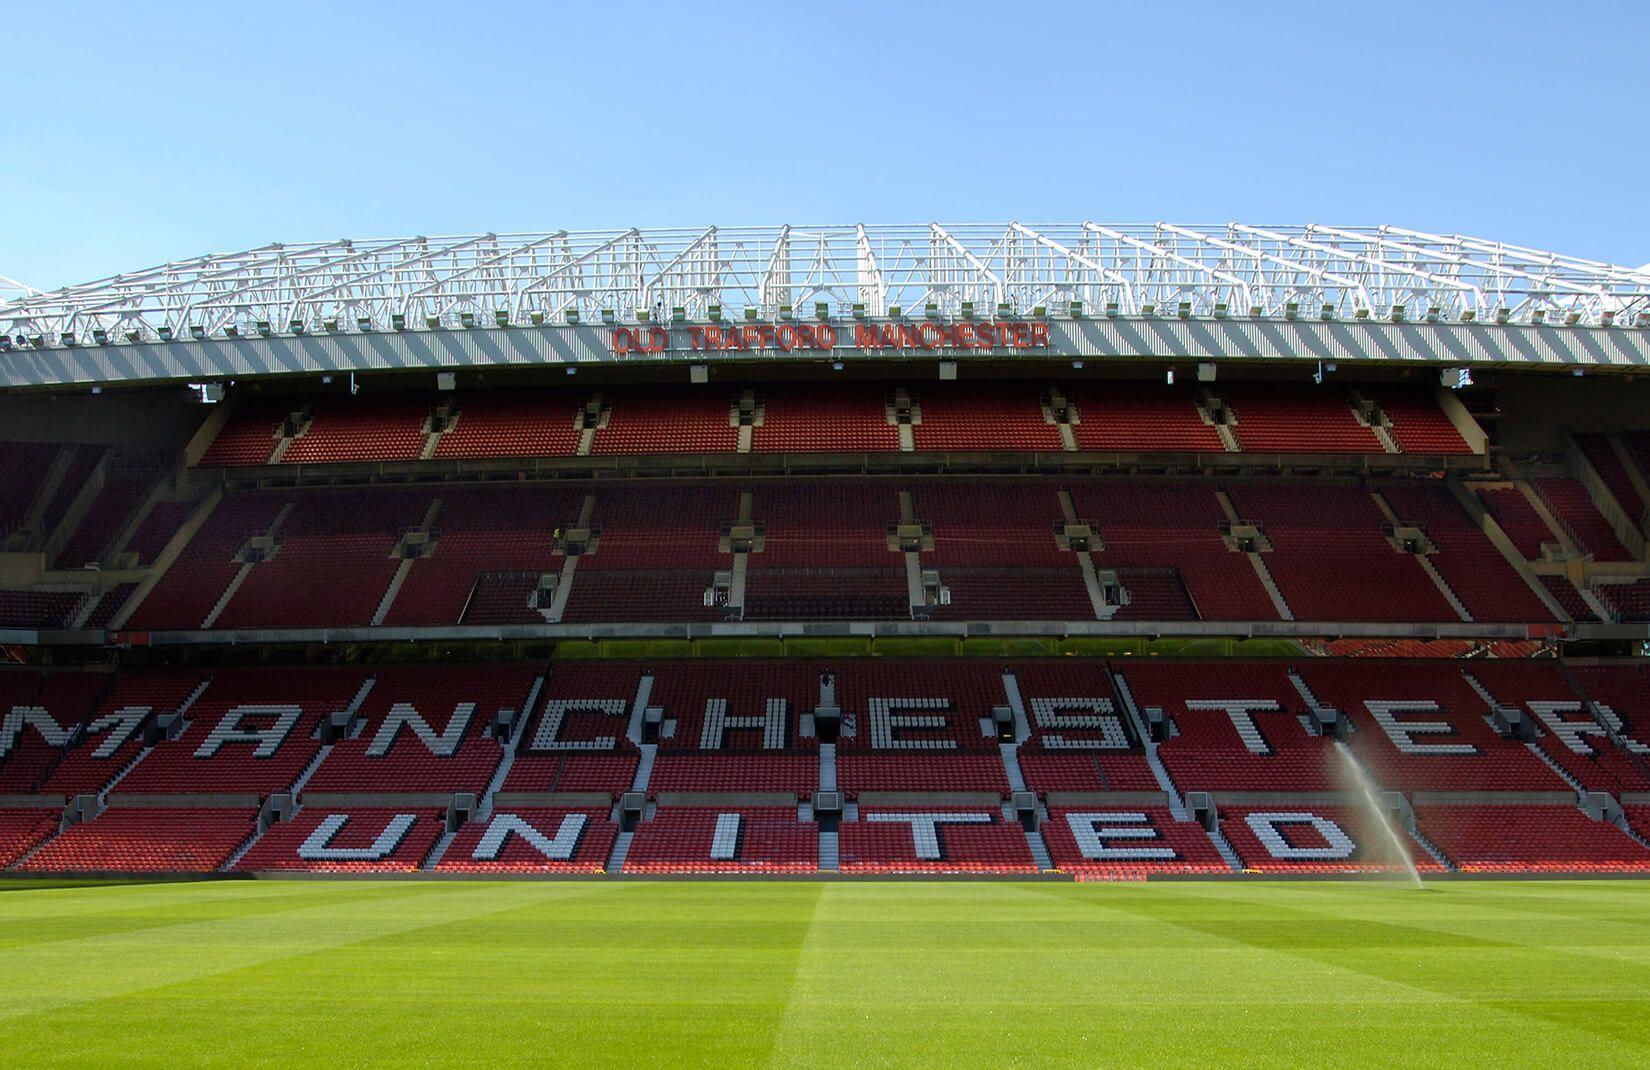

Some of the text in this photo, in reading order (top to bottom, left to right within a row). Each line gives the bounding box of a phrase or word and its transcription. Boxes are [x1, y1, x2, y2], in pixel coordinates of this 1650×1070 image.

[612, 321, 1049, 354] OLD TRAFFORD MANCHESTER
[0, 697, 1650, 758] MANCHESTER
[297, 812, 1356, 860] UNITED
